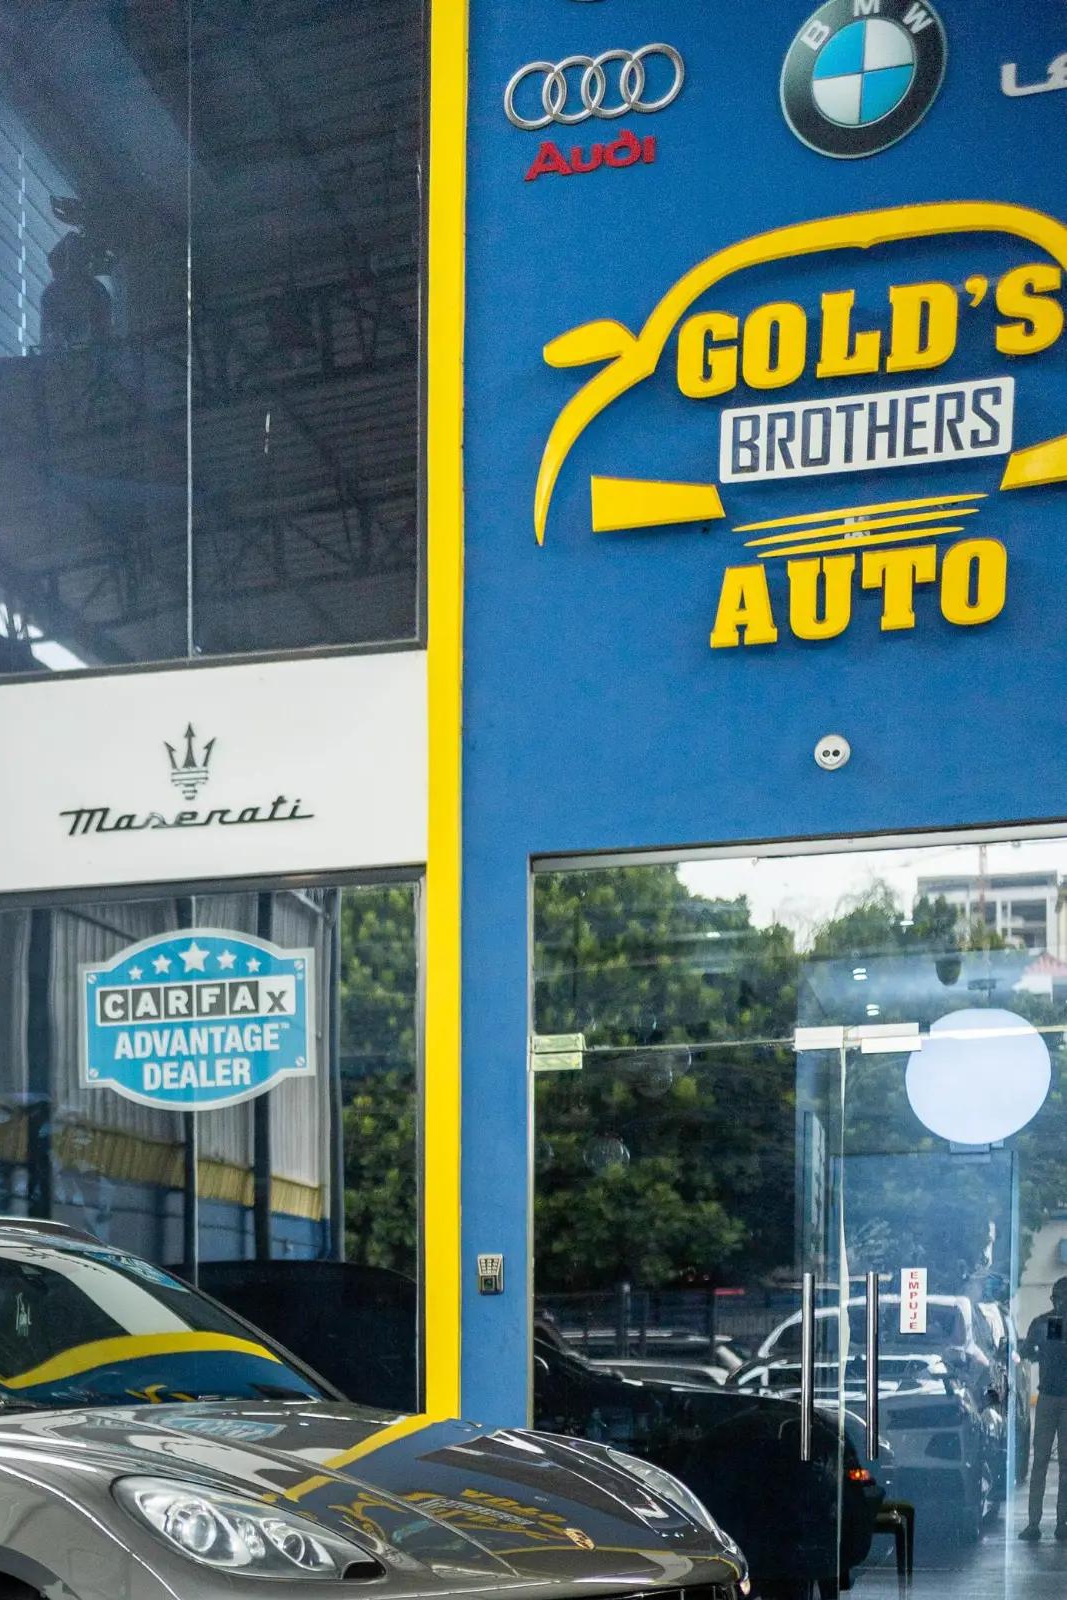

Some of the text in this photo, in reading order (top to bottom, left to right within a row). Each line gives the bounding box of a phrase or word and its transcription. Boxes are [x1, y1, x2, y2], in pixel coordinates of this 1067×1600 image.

[800, 0, 933, 51] BMW
[524, 129, 655, 181] Audi
[676, 263, 1065, 398] GOLD'S
[731, 386, 1003, 475] BROTHERS
[709, 537, 1007, 648] AUTO
[59, 796, 315, 836] Maserati
[102, 985, 288, 1019] CARFAX
[114, 1022, 280, 1060] ADVANTAGE
[142, 1057, 251, 1091] DEALER
[908, 1271, 919, 1330] EMPUJE
